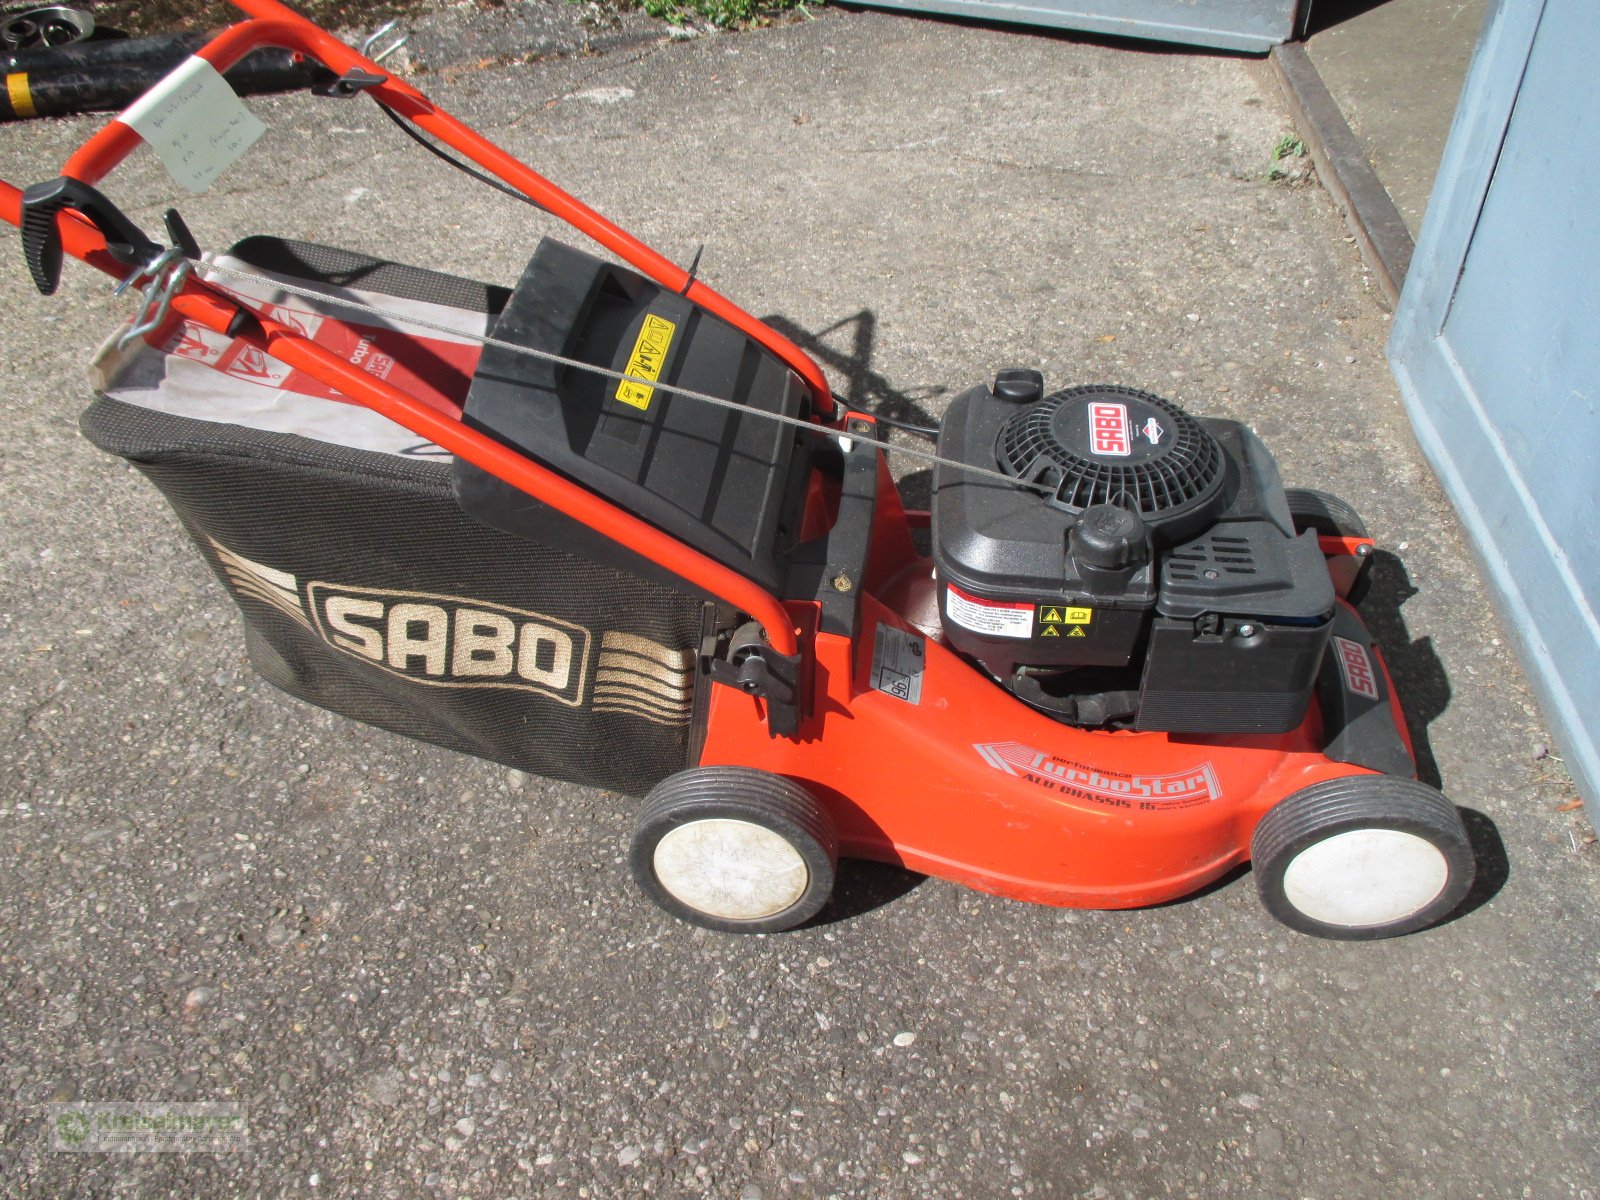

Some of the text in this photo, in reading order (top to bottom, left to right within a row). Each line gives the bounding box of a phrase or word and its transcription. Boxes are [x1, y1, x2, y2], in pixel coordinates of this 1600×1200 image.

[350, 335, 376, 363] Turbo
[1093, 404, 1126, 453] SABO
[325, 596, 573, 690] SABO
[891, 681, 907, 697] 96
[1338, 638, 1376, 697] SABO
[1022, 773, 1056, 789] ALU
[1059, 785, 1132, 809] CHASSIS
[1031, 752, 1208, 797] TurboStar
